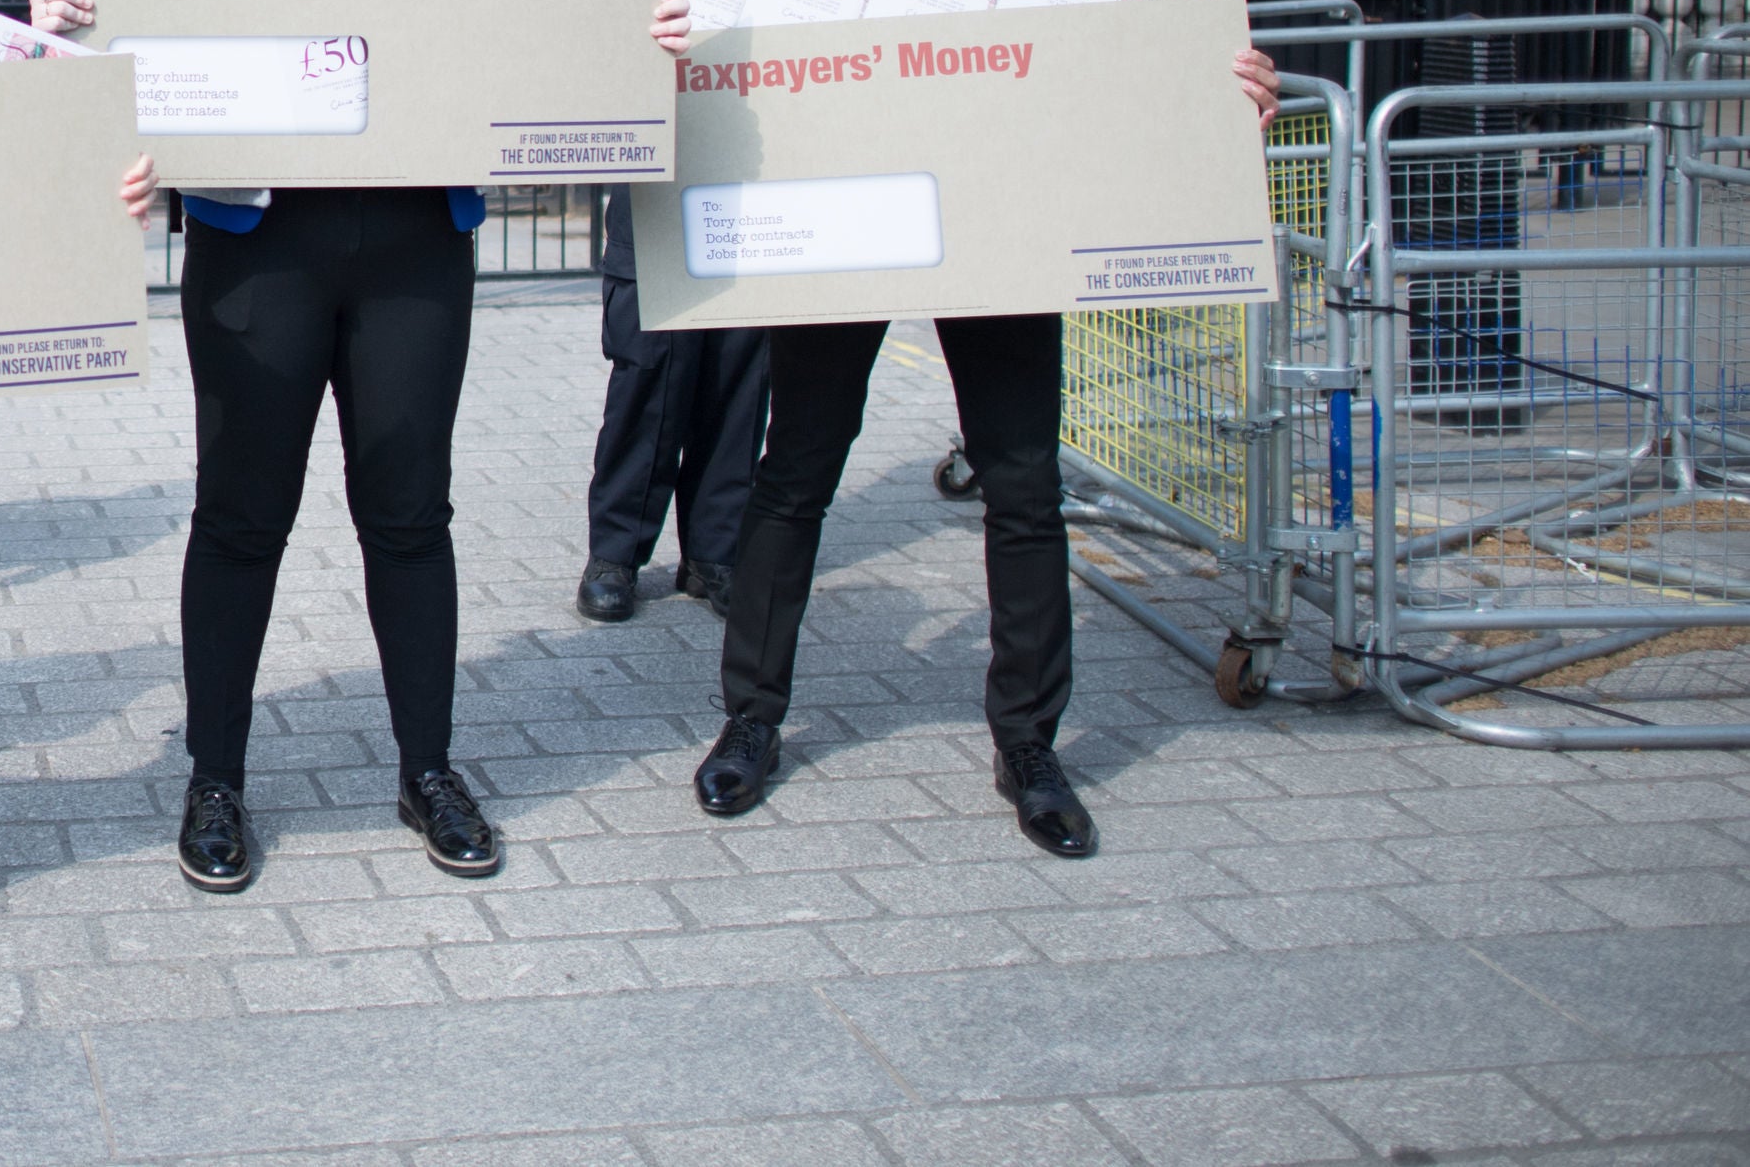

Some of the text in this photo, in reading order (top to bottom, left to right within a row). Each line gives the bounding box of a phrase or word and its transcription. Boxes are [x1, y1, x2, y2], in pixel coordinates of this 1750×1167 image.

[134, 55, 148, 65] o:
[300, 35, 369, 80] £50
[675, 41, 1034, 97] Taxpayers’ Money
[135, 71, 209, 85] ory chums
[135, 89, 239, 102] odgy contracts
[136, 105, 227, 116] obs for mates
[520, 132, 637, 144] IF FOUND PLEASE RETURN TO:
[501, 146, 656, 164] THE CONSERVATIVE PARTY
[702, 201, 723, 212] To:
[703, 215, 783, 229] Tory chums
[705, 229, 815, 245] Dodgy contracts
[706, 246, 804, 260] Jobs for mates
[1104, 253, 1232, 270] IF FOUND PLEASE RETURN TO:
[1085, 266, 1255, 290] THE CONSERVATIVE PARTY
[17, 340, 50, 354] PLEASE
[53, 337, 88, 351] RETURN
[90, 336, 105, 348] TO:
[87, 350, 127, 368] PARTY
